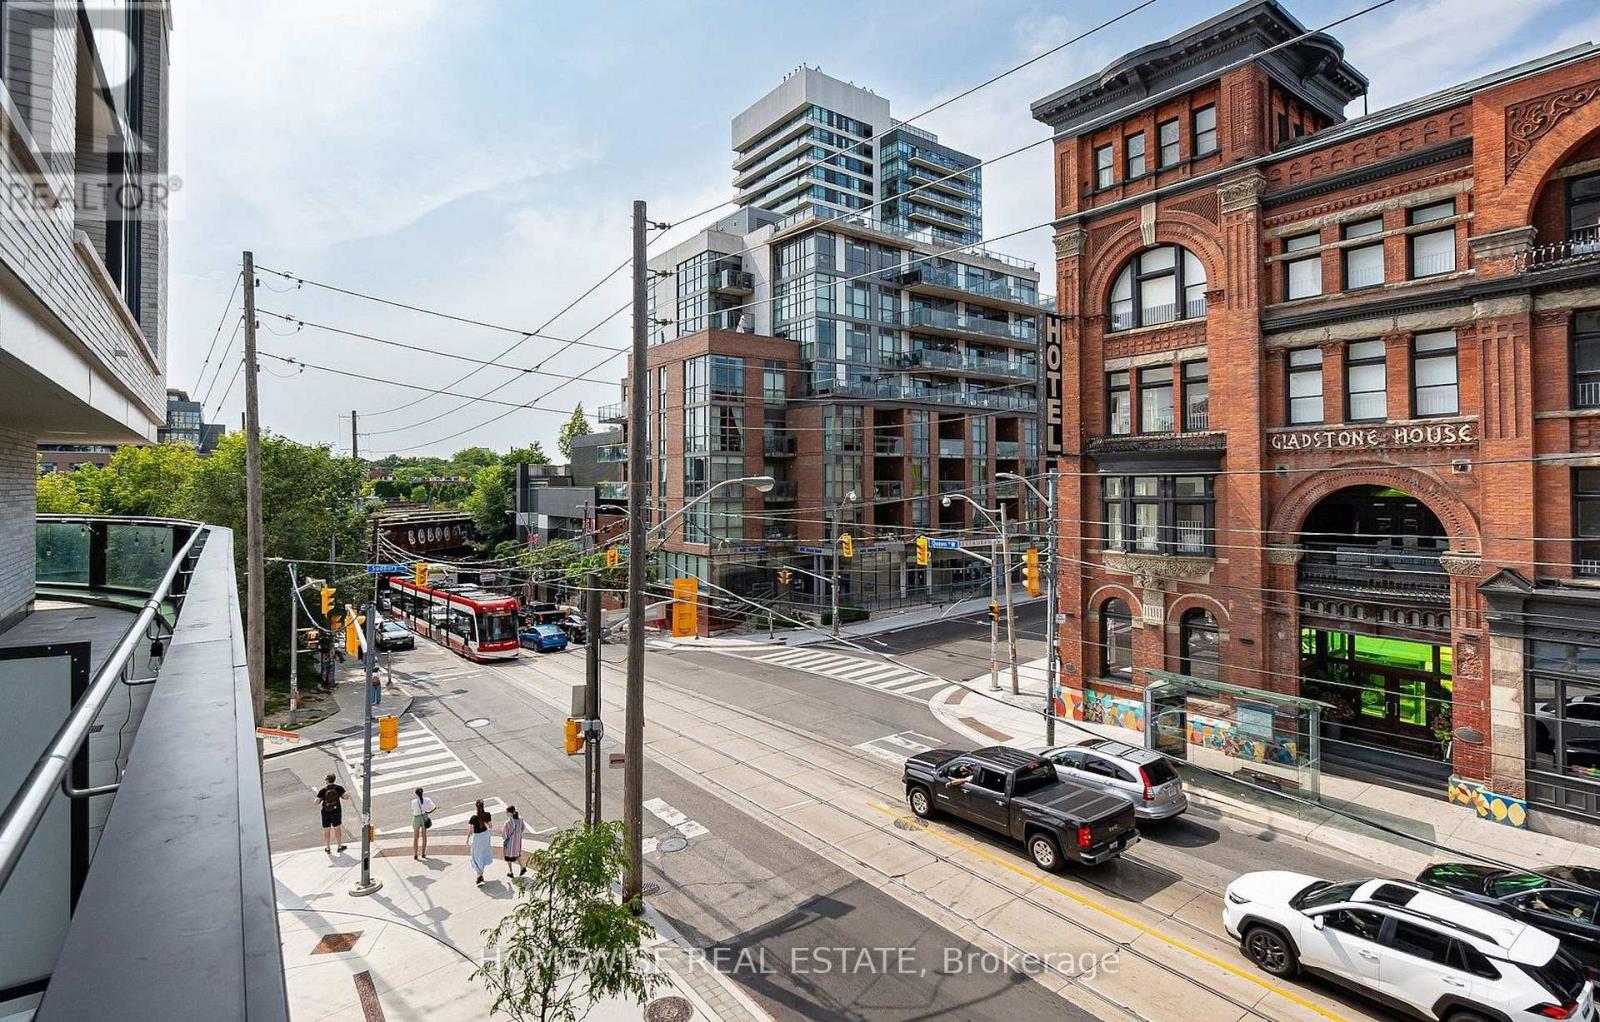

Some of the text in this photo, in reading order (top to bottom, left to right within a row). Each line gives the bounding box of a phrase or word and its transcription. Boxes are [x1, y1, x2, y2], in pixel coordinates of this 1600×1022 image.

[1046, 316, 1061, 452] HOTEL
[1271, 424, 1474, 450] GLADSTONE HOUSE
